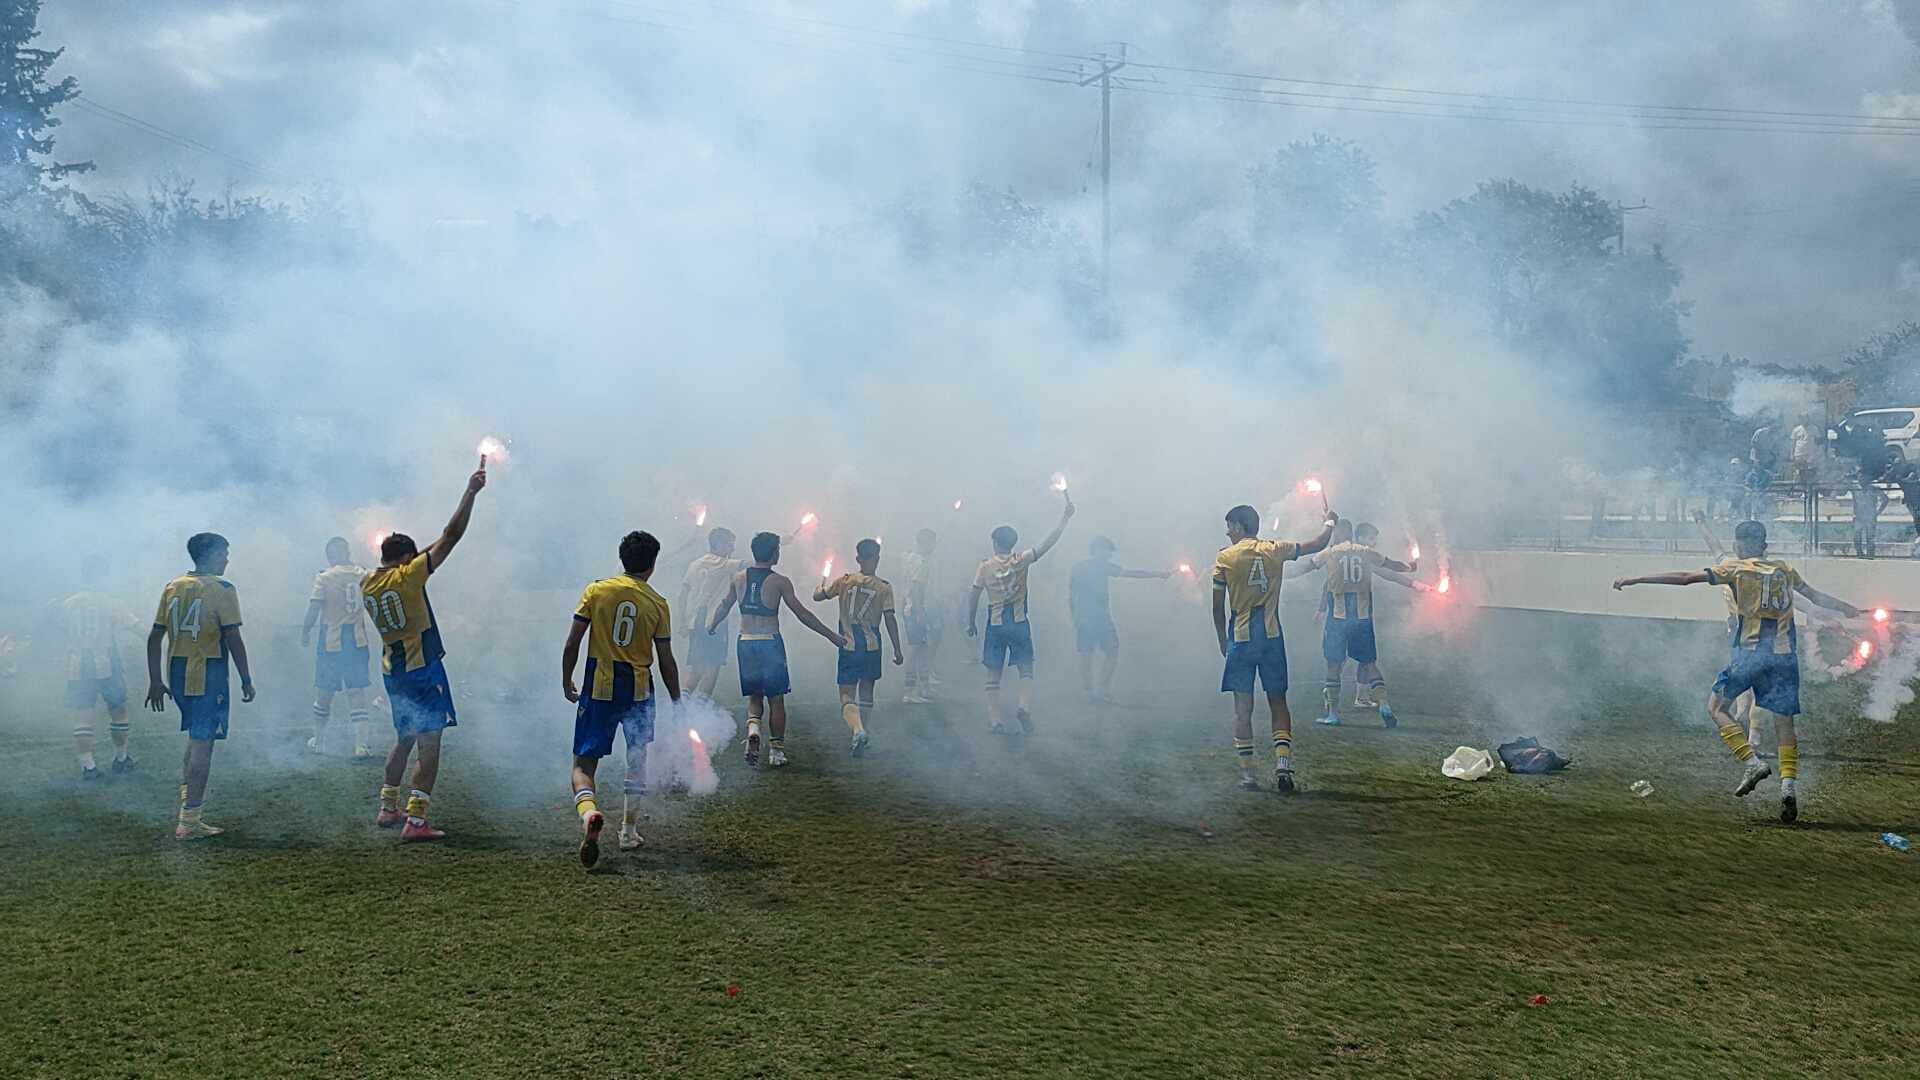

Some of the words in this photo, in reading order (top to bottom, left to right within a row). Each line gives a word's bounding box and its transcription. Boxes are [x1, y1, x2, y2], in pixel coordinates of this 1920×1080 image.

[1247, 556, 1269, 593] 4
[1339, 555, 1362, 583] 16
[169, 596, 202, 642] 14
[363, 590, 407, 632] 20
[612, 600, 638, 647] 6
[848, 585, 876, 624] 17
